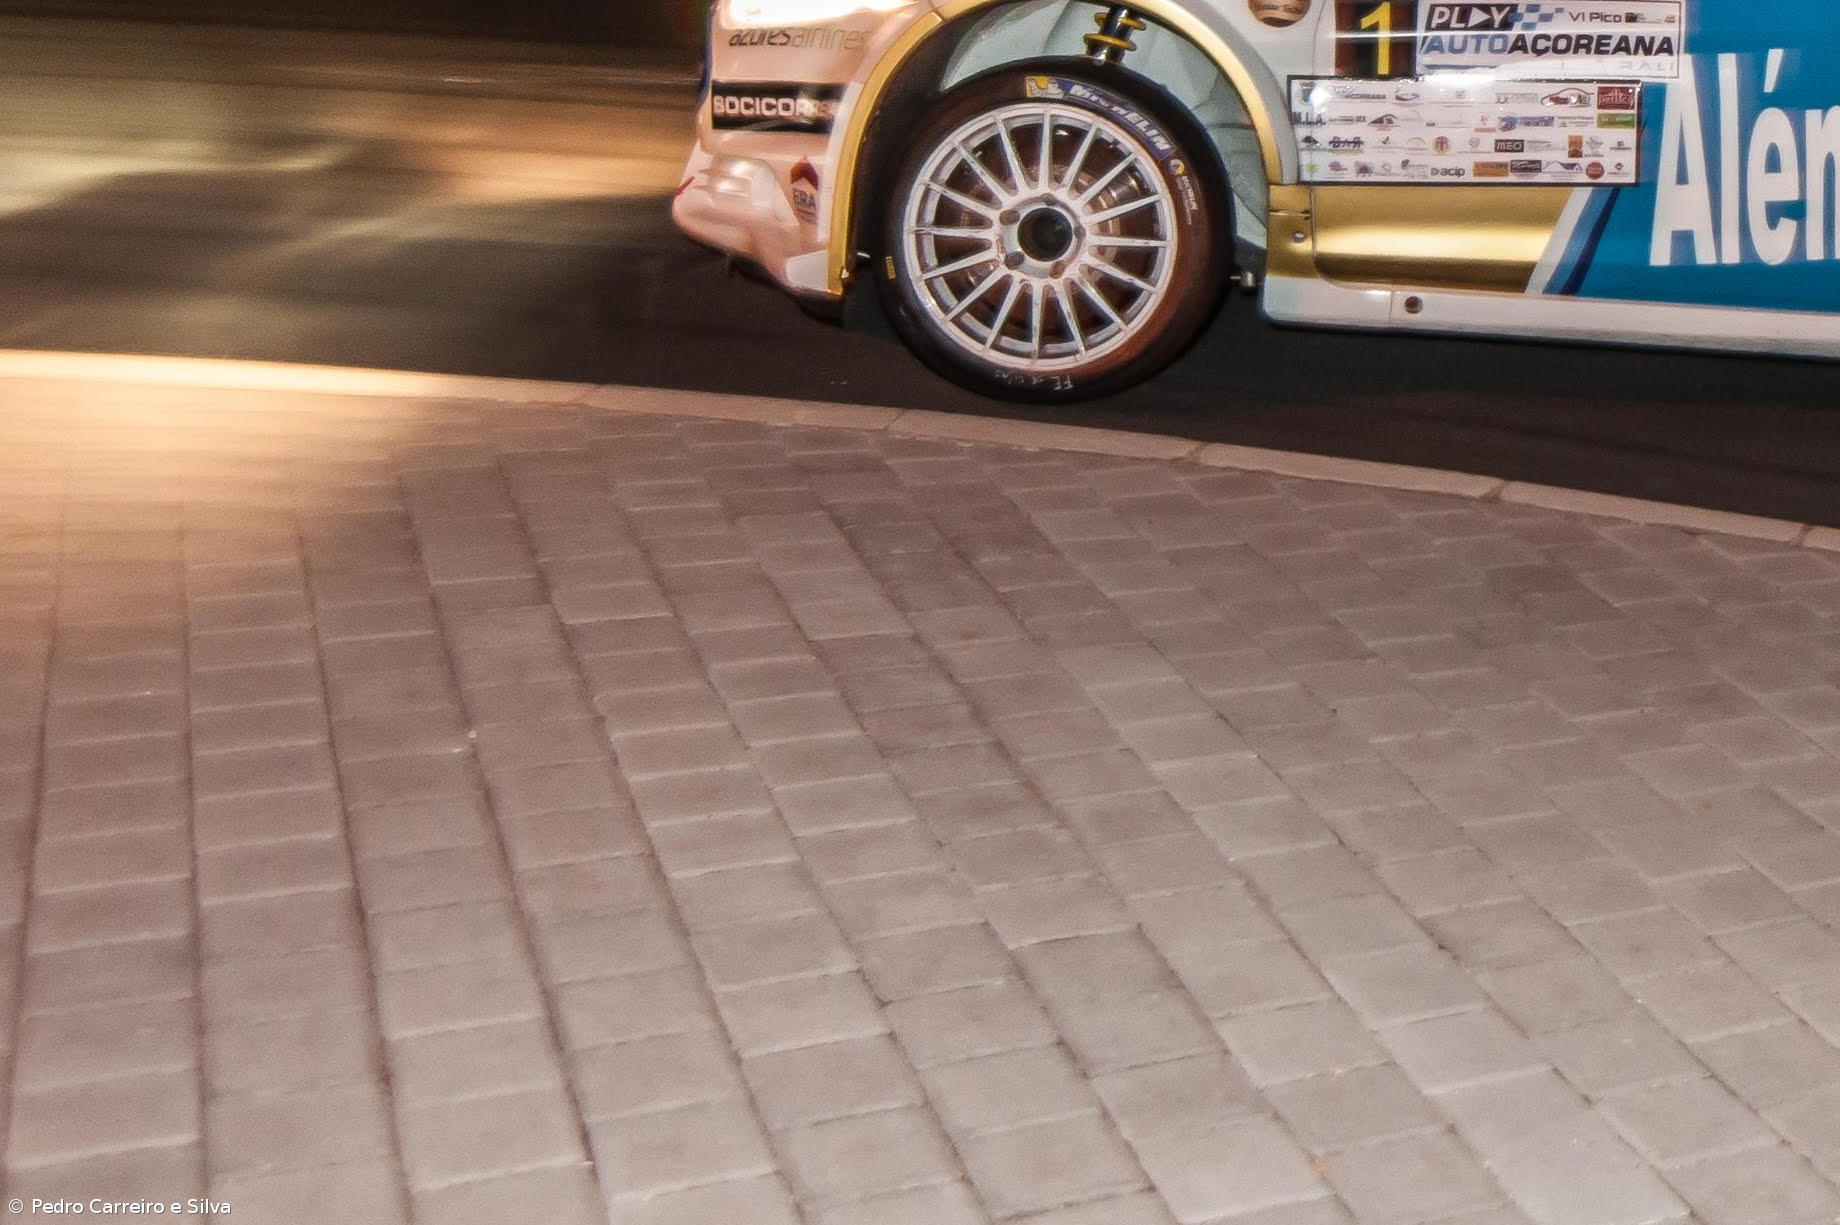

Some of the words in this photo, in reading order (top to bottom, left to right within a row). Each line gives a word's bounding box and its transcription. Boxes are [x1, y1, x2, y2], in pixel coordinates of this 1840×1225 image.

[1359, 0, 1392, 76] 1
[1568, 10, 1586, 23] VI
[1589, 10, 1623, 24] Pico
